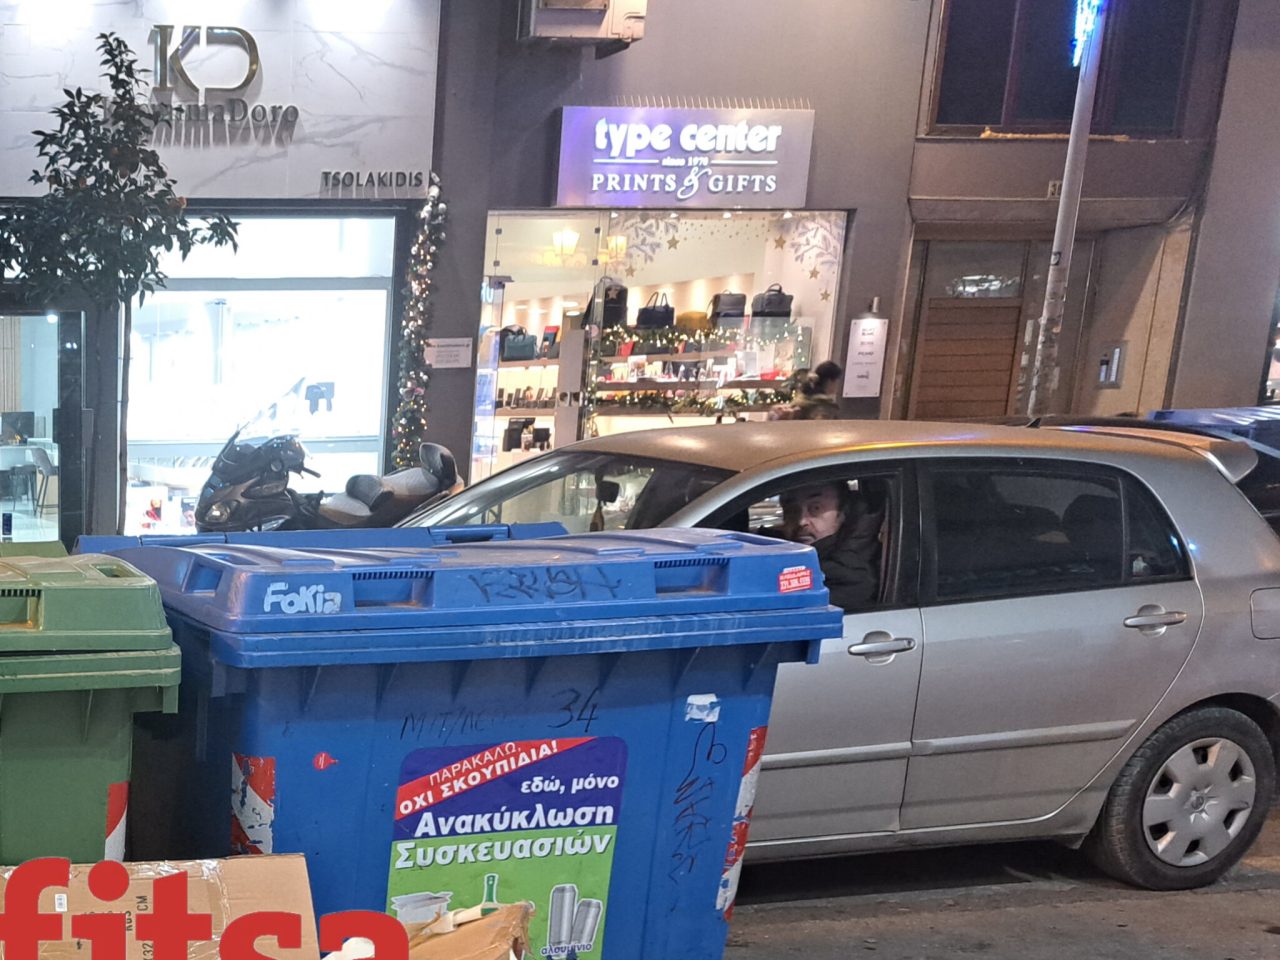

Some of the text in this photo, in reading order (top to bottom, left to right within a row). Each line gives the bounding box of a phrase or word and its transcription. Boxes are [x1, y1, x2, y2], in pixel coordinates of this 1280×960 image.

[594, 117, 783, 158] type center
[321, 170, 424, 188] TSOLAKIDIS
[592, 166, 778, 199] PRINTS & GIFTS
[429, 741, 522, 787] ΠΑΡΑΚΑΛΩ,
[440, 739, 559, 798] ΣΚΟΥΠΙΔΙΑ!
[521, 774, 619, 794] εδώ, μόνο
[414, 803, 614, 838] Ανακύκλωση
[394, 830, 613, 869] Συσκευασιών
